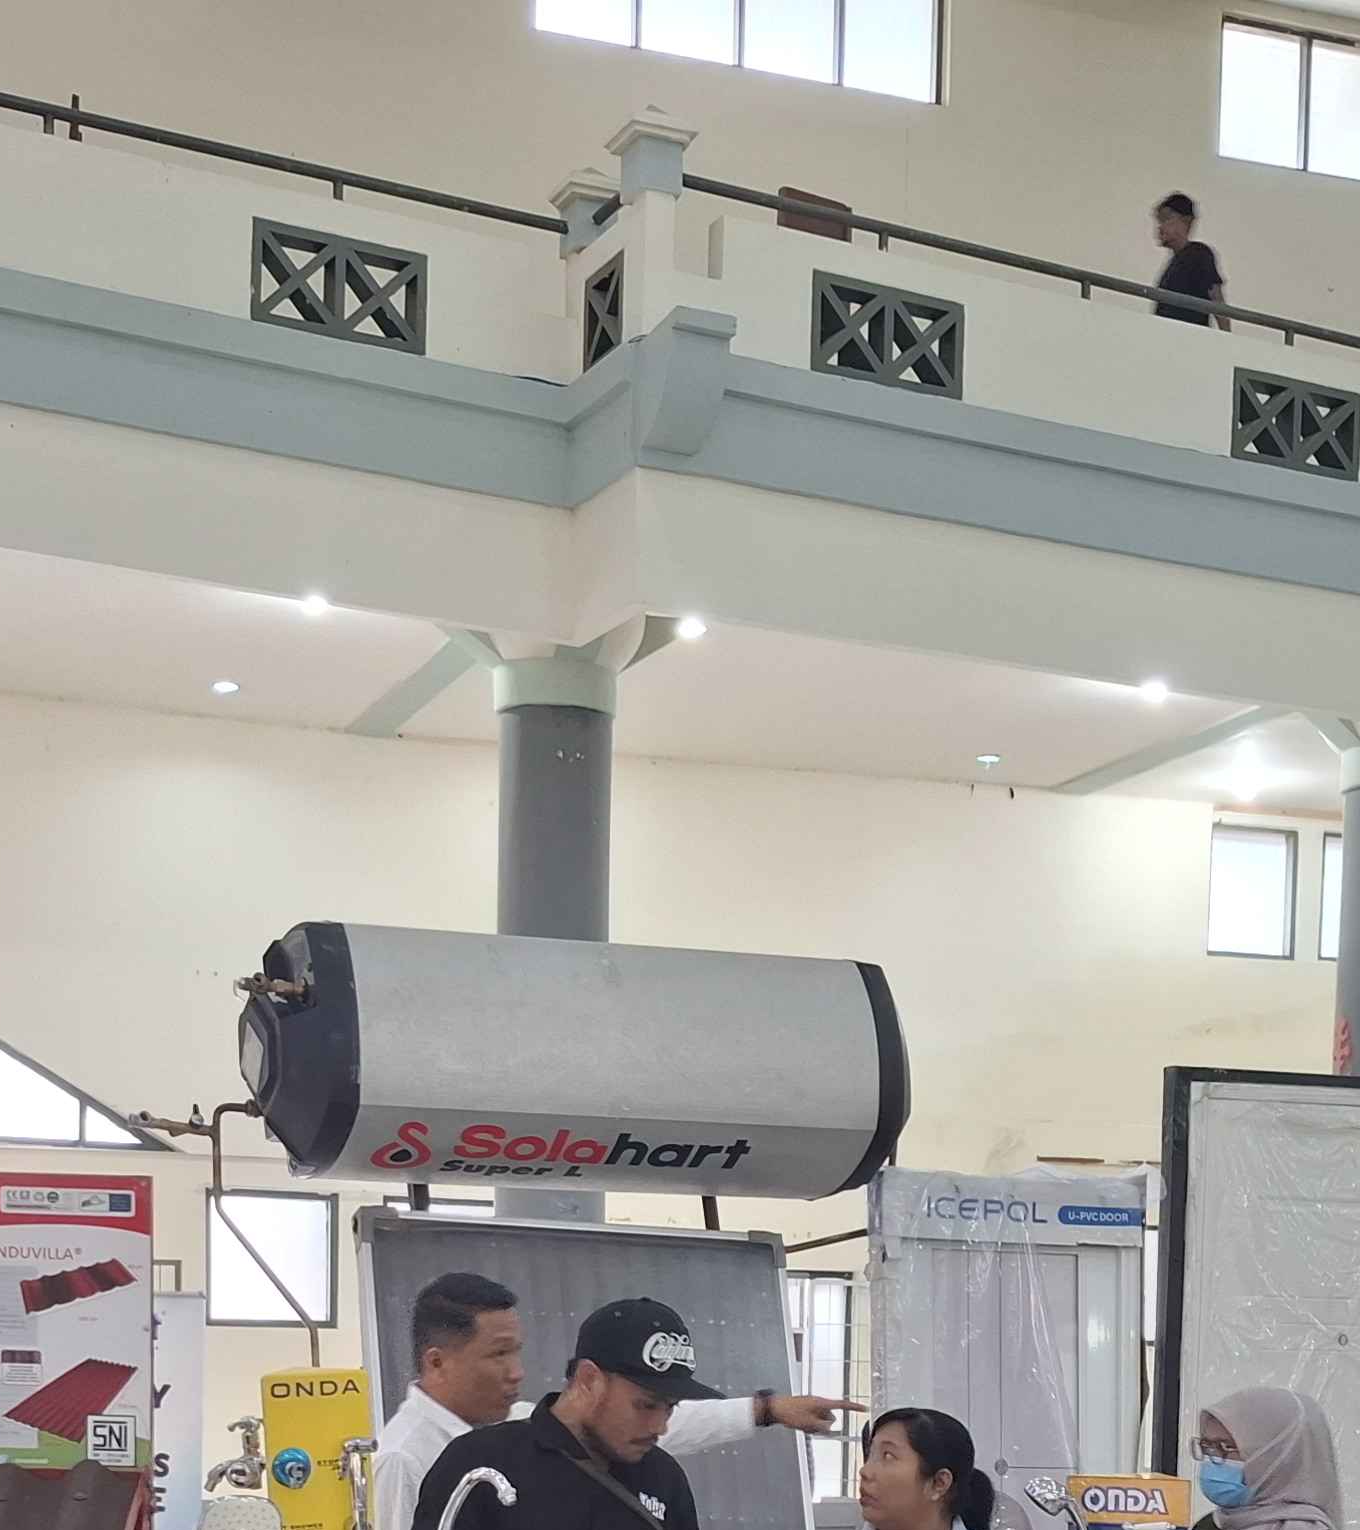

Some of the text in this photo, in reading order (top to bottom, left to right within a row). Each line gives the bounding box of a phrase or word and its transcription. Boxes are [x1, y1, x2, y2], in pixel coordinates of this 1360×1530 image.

[453, 1123, 750, 1171] Solahart
[439, 1159, 582, 1178] Super L
[926, 1195, 1048, 1224] ICEPOL
[1067, 1211, 1129, 1223] U-PVC DOOR
[270, 1379, 361, 1398] ONDA
[92, 1425, 128, 1448] SNI
[1082, 1485, 1167, 1516] ONDA
